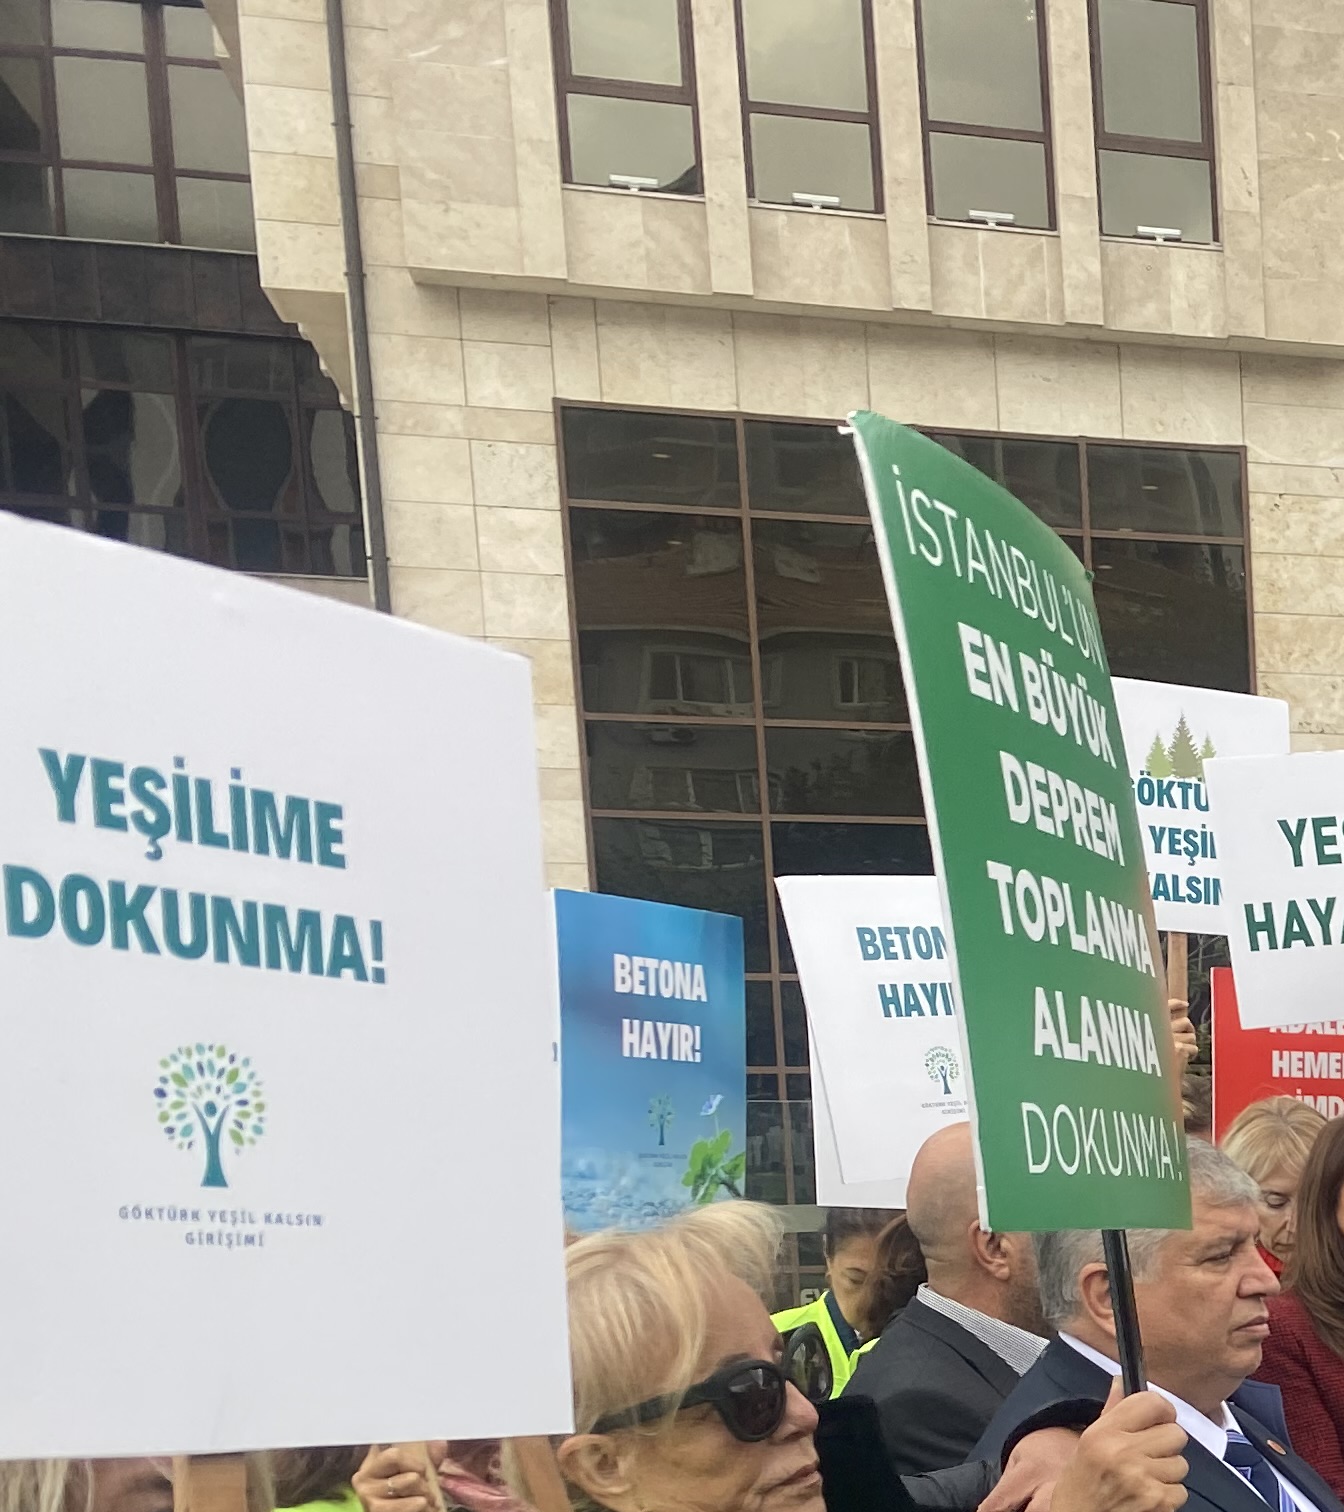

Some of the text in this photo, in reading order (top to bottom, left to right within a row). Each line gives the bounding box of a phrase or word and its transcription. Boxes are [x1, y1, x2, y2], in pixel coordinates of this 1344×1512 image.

[958, 622, 1117, 769] EN BÜYÜK
[38, 748, 347, 869] YEŞİLİME
[1000, 750, 1125, 867] DEPREM
[2, 863, 386, 984] DOKUNMA!
[986, 860, 1156, 978] TOPLANMA
[613, 953, 708, 1002] BETONA
[877, 982, 956, 1018] HAYI
[622, 1018, 702, 1063] HAYIR!
[1034, 986, 1162, 1077] ALANINA
[1021, 1101, 1183, 1181] DOKUNMA!
[118, 1204, 323, 1227] GÖKTÜRK YEŞİL KALSIN
[185, 1229, 264, 1249] GİRİŞİMİ
